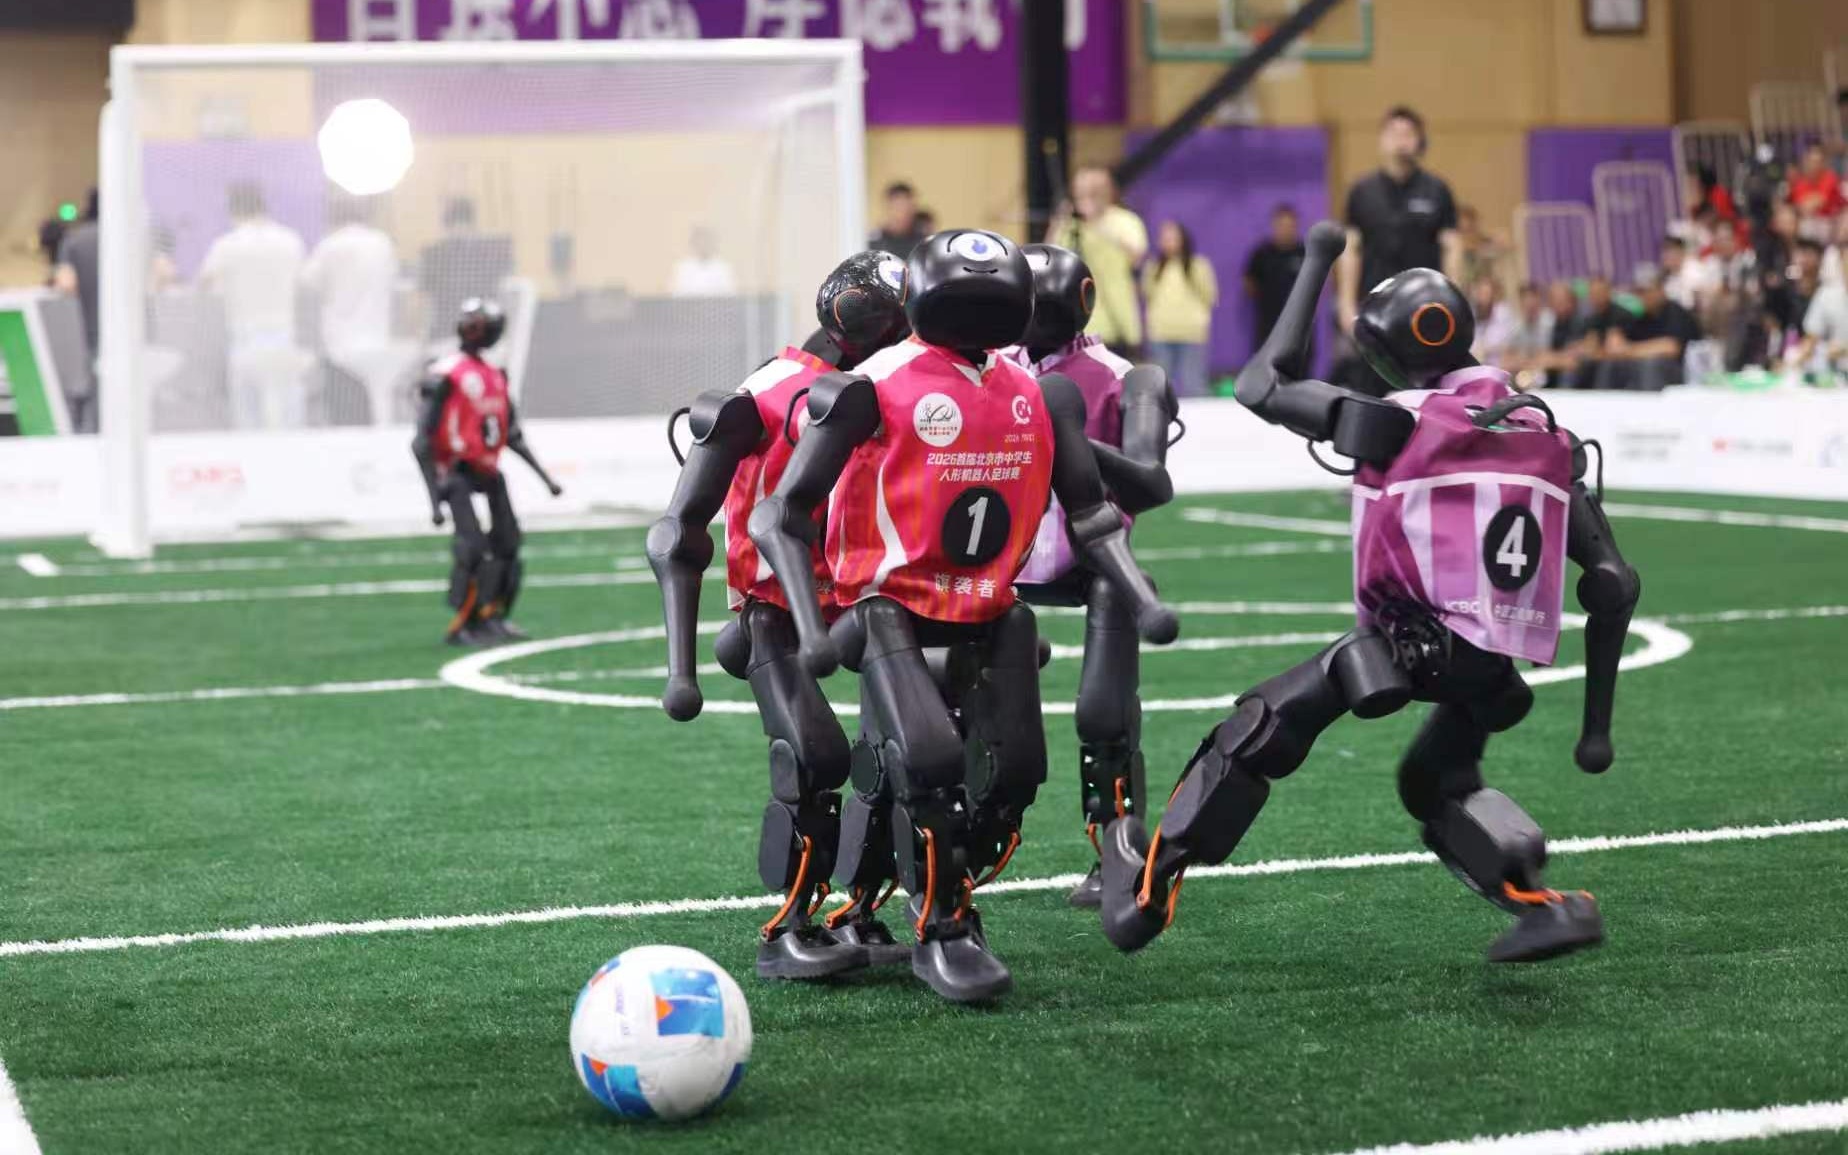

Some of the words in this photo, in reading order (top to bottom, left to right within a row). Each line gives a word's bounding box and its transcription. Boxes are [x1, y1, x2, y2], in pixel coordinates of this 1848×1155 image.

[926, 450, 1032, 467] 2026首届北京市中学生
[940, 466, 1021, 482] 人形机器人足球赛
[966, 496, 989, 556] 1
[1496, 515, 1528, 577] 4
